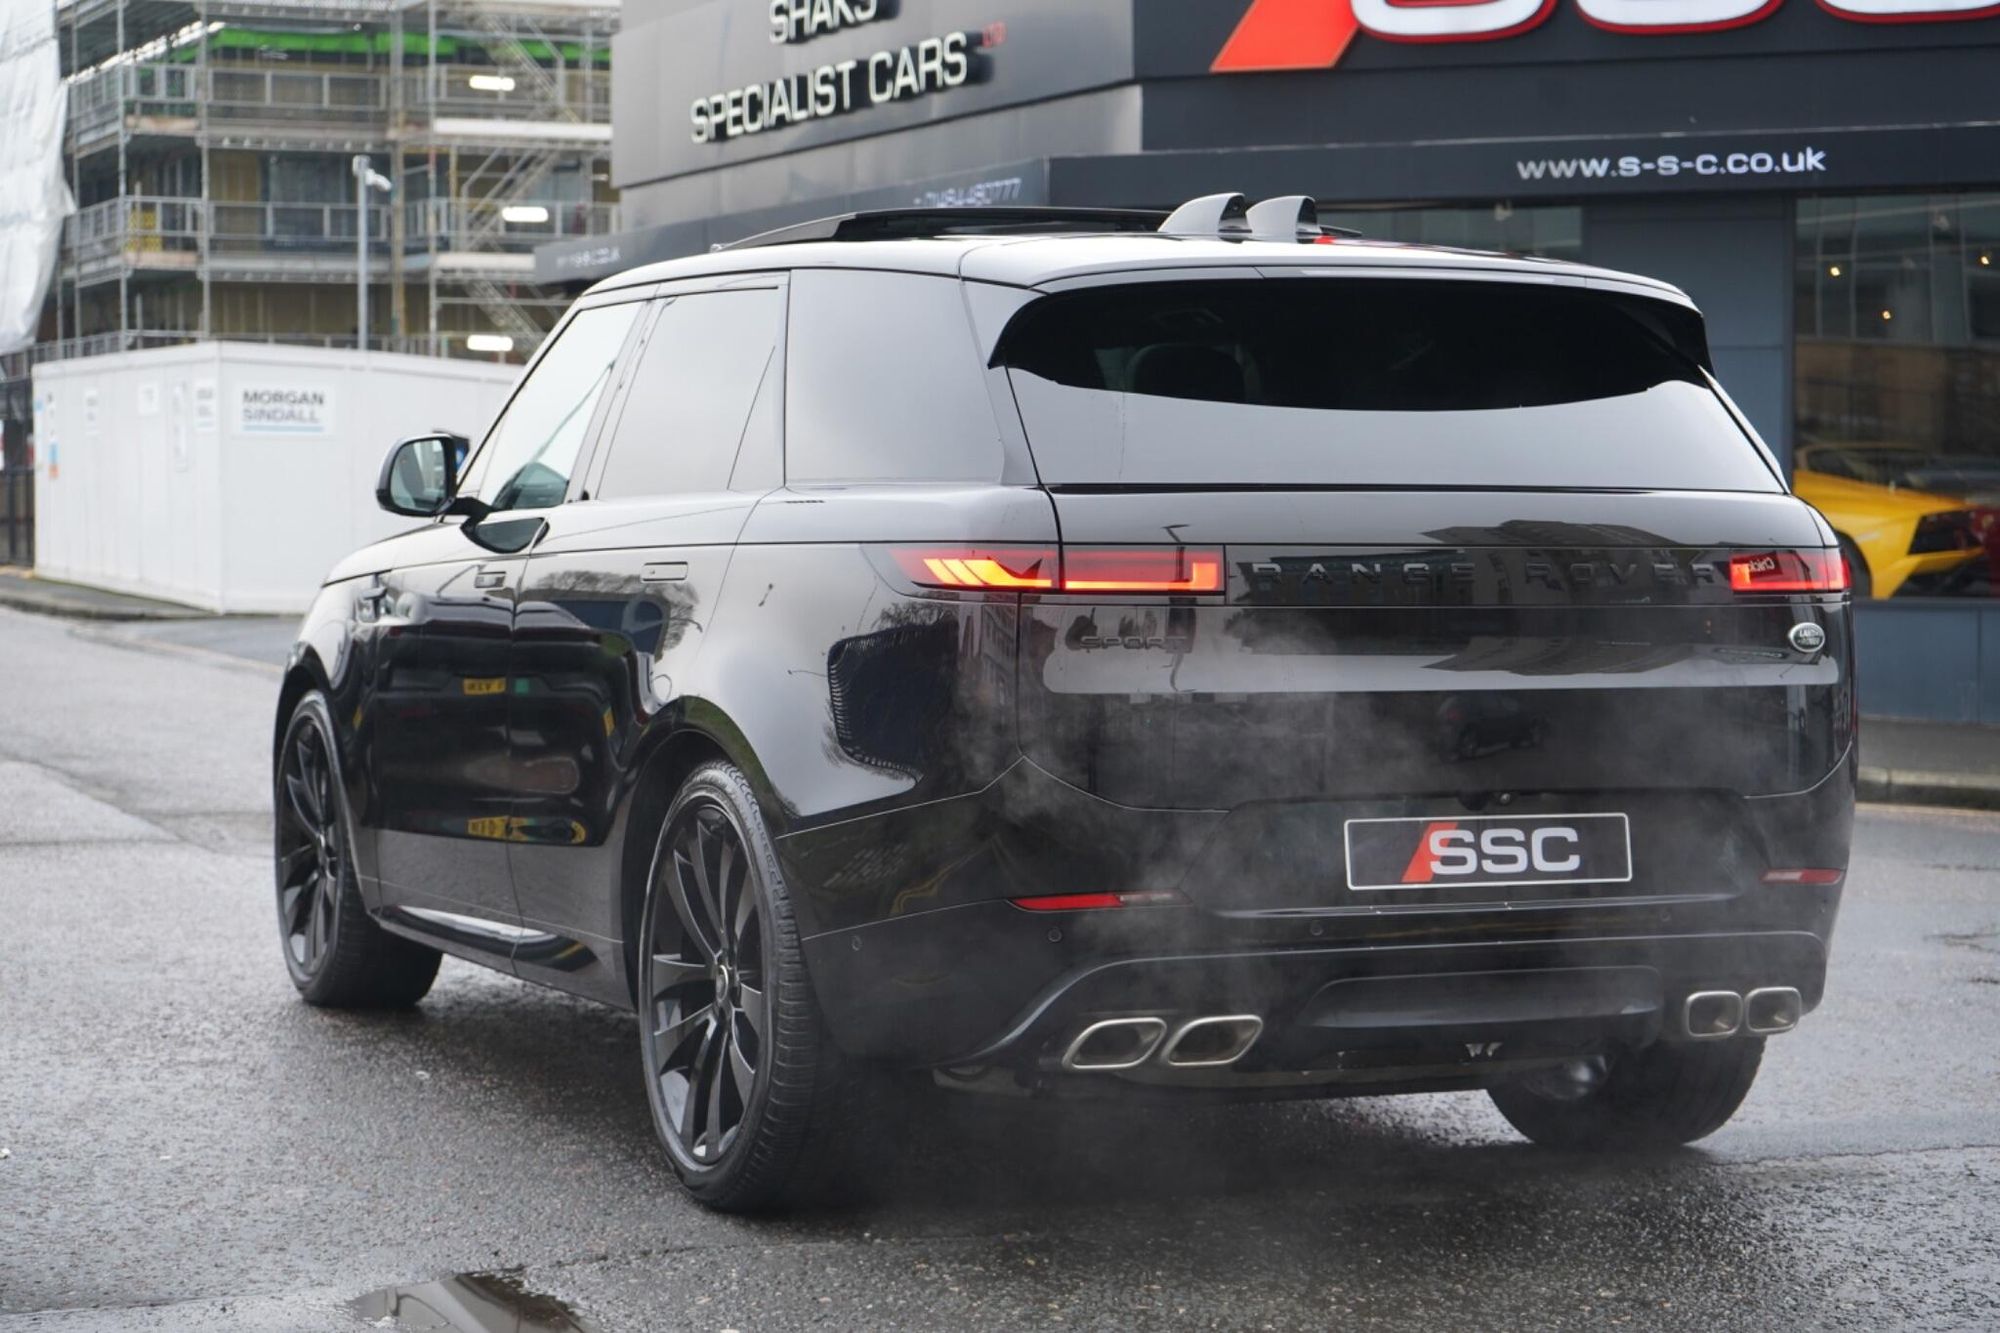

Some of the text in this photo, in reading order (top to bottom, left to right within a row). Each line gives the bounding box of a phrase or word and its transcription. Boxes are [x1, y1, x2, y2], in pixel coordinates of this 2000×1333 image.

[690, 31, 968, 143] SPECIALIST CARS
[1517, 147, 1827, 180] www.s-s-c.co.uk
[242, 389, 324, 405] MORGAN
[242, 407, 320, 422] SINDALL
[1251, 562, 1715, 585] RANGE ROVER
[1079, 635, 1188, 650] SPORT
[1428, 826, 1581, 876] SSC
